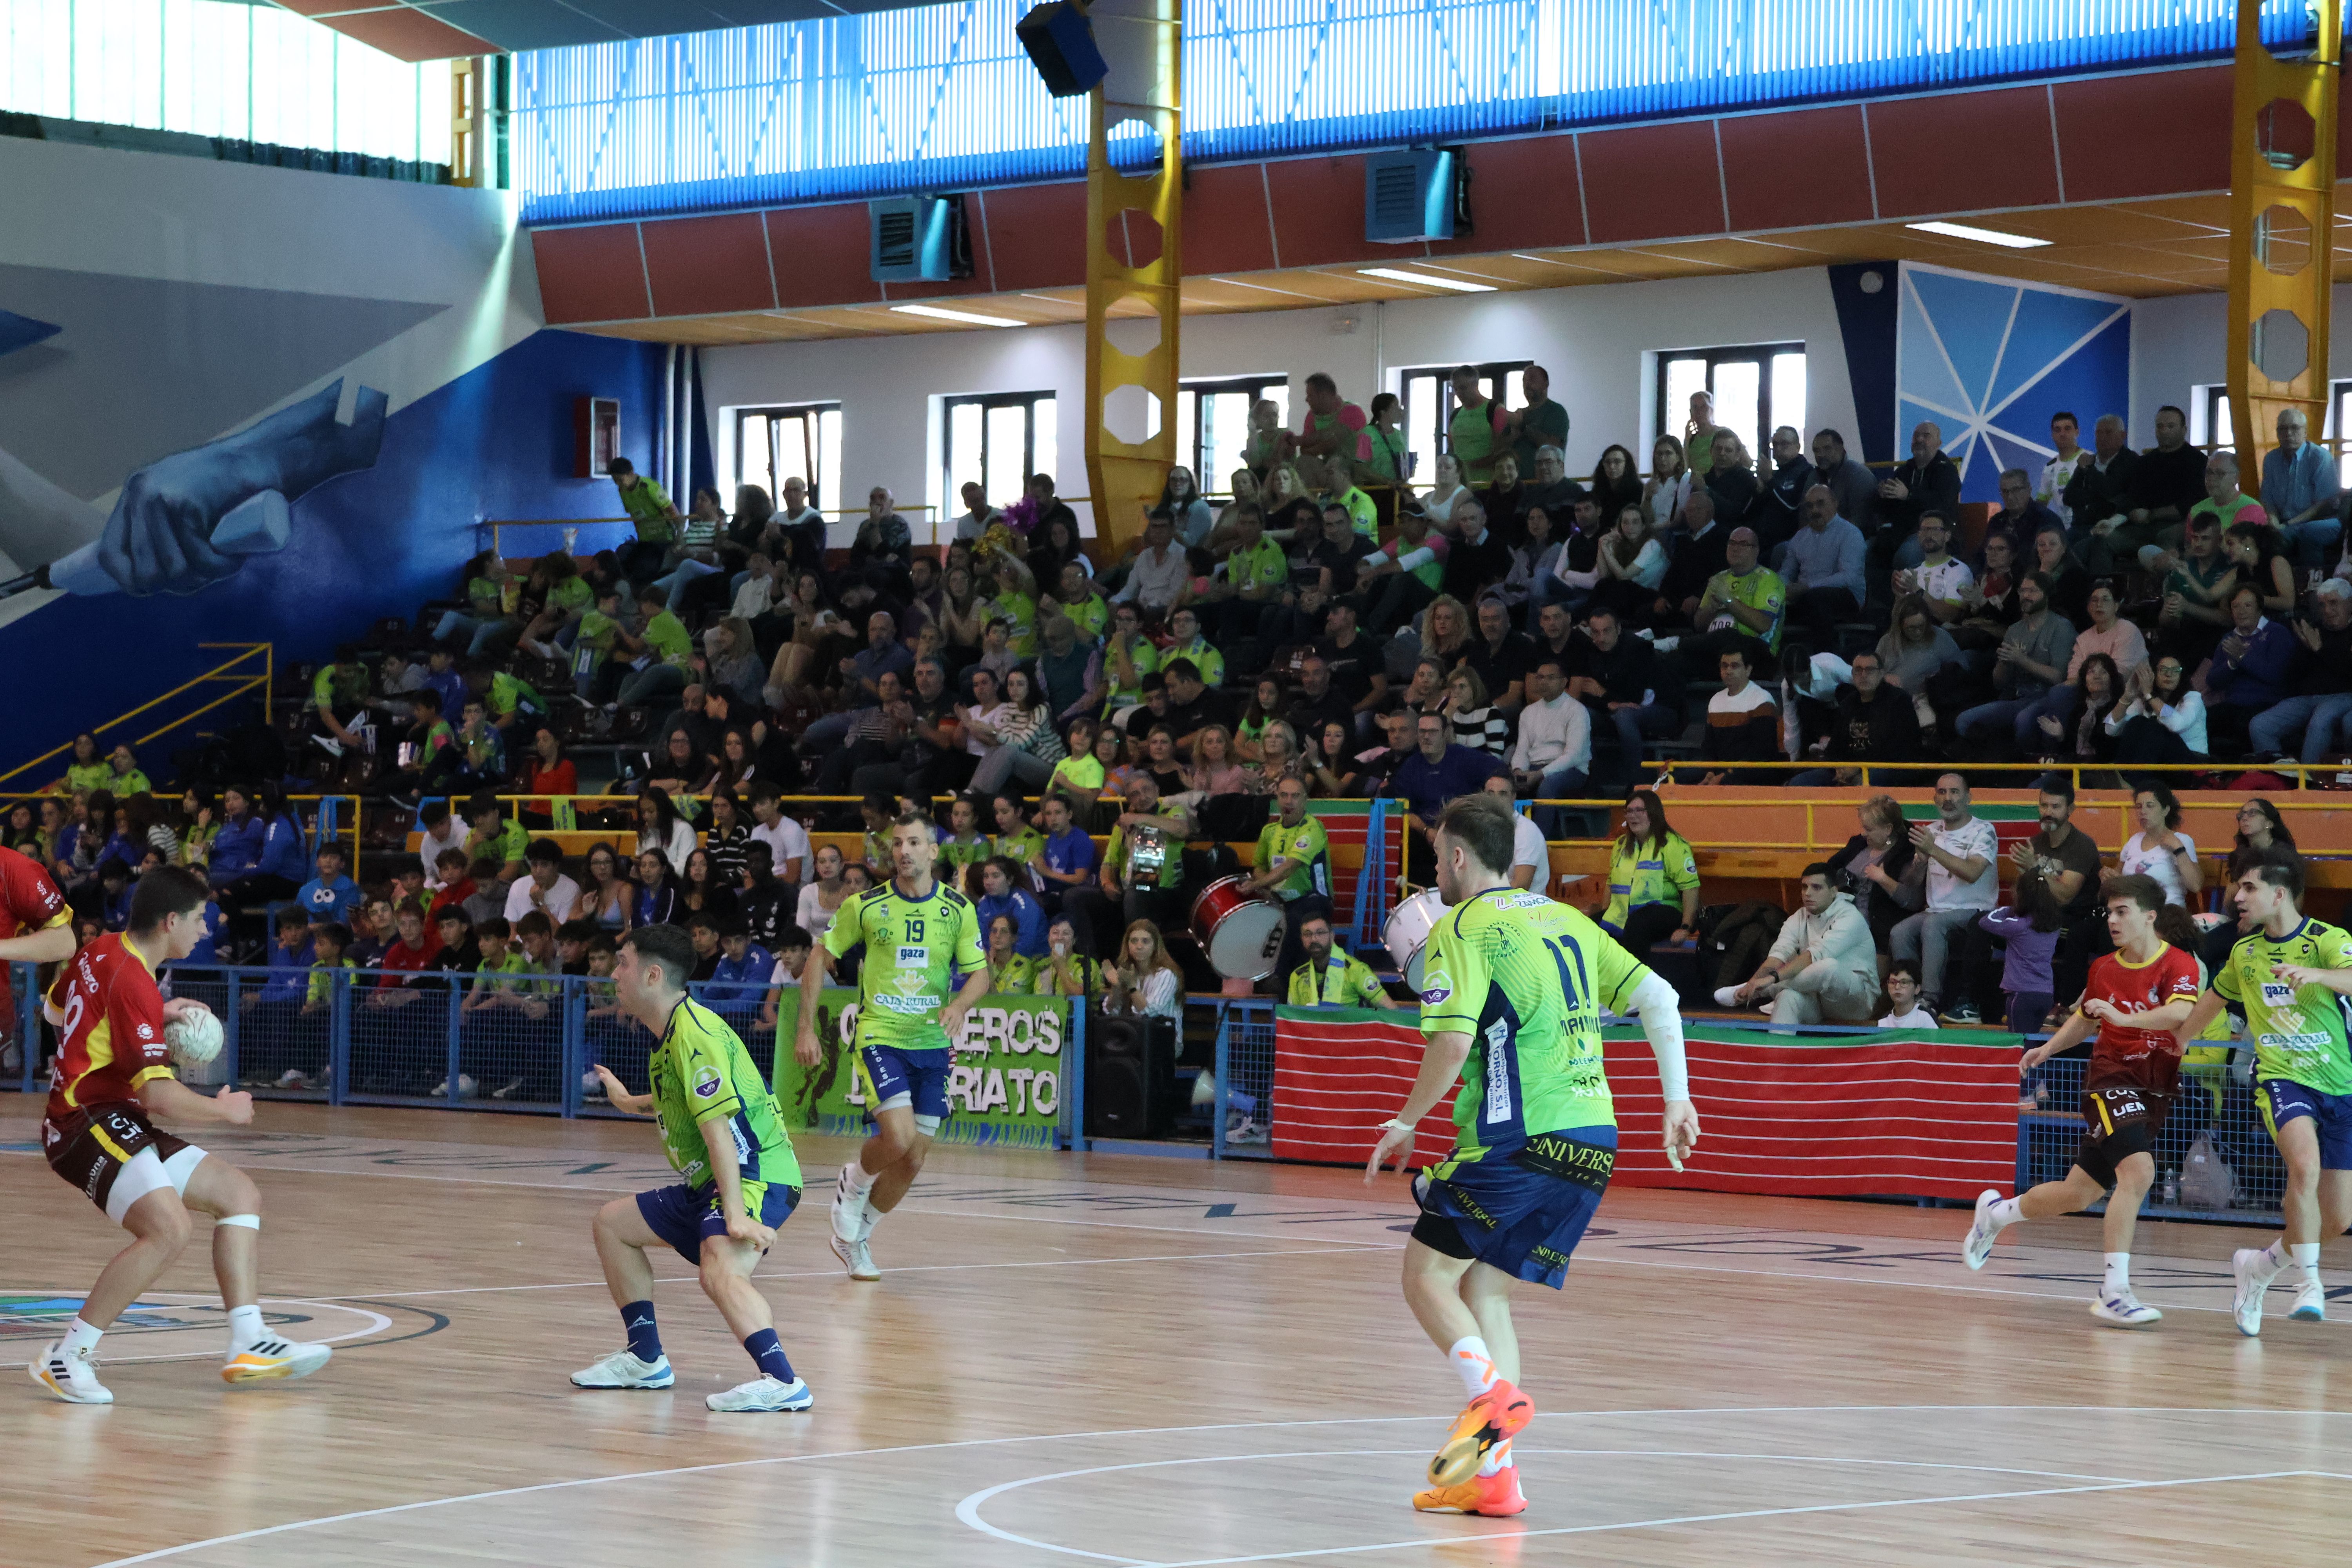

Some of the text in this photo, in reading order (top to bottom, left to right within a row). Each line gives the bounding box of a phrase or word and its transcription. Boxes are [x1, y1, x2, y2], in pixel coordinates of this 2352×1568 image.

[905, 919, 924, 942] 19
[900, 949, 925, 960] gaza
[1542, 934, 1591, 1012] 11
[2265, 986, 2290, 998] gaza
[875, 995, 940, 1006] CAJA RURAL
